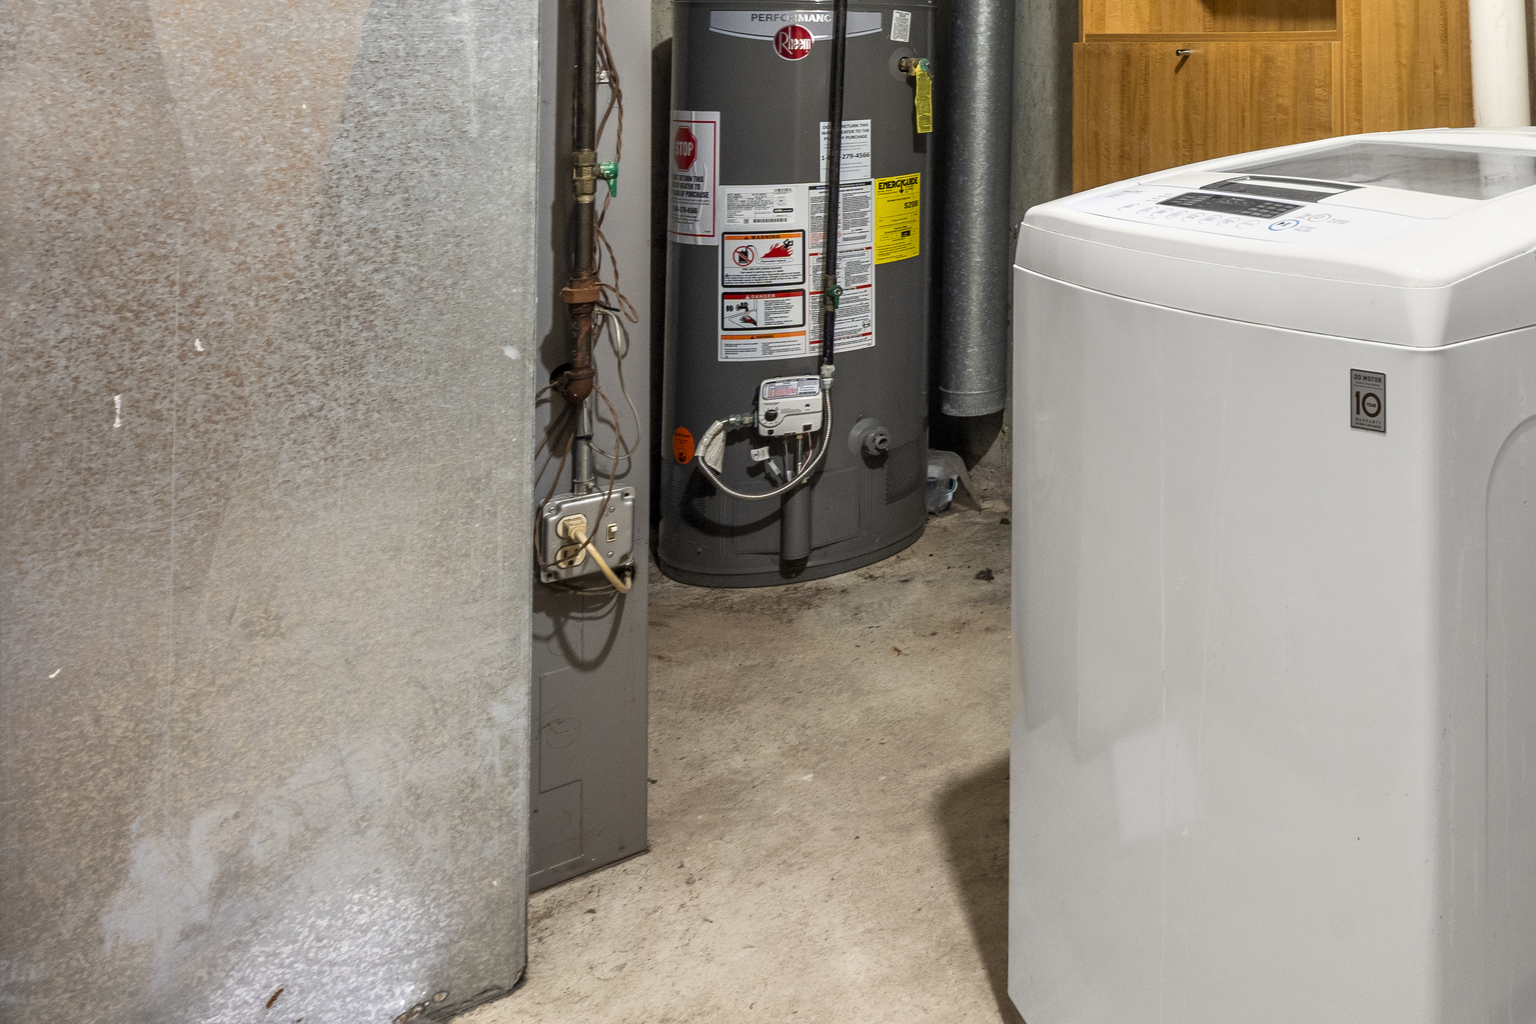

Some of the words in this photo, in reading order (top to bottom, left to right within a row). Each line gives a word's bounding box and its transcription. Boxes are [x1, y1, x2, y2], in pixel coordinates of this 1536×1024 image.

[751, 14, 832, 22] PERFORMANC
[778, 26, 812, 54] Rheem
[675, 141, 694, 156] STOP
[1362, 375, 1382, 383] MOTOR
[1355, 391, 1381, 418] 10
